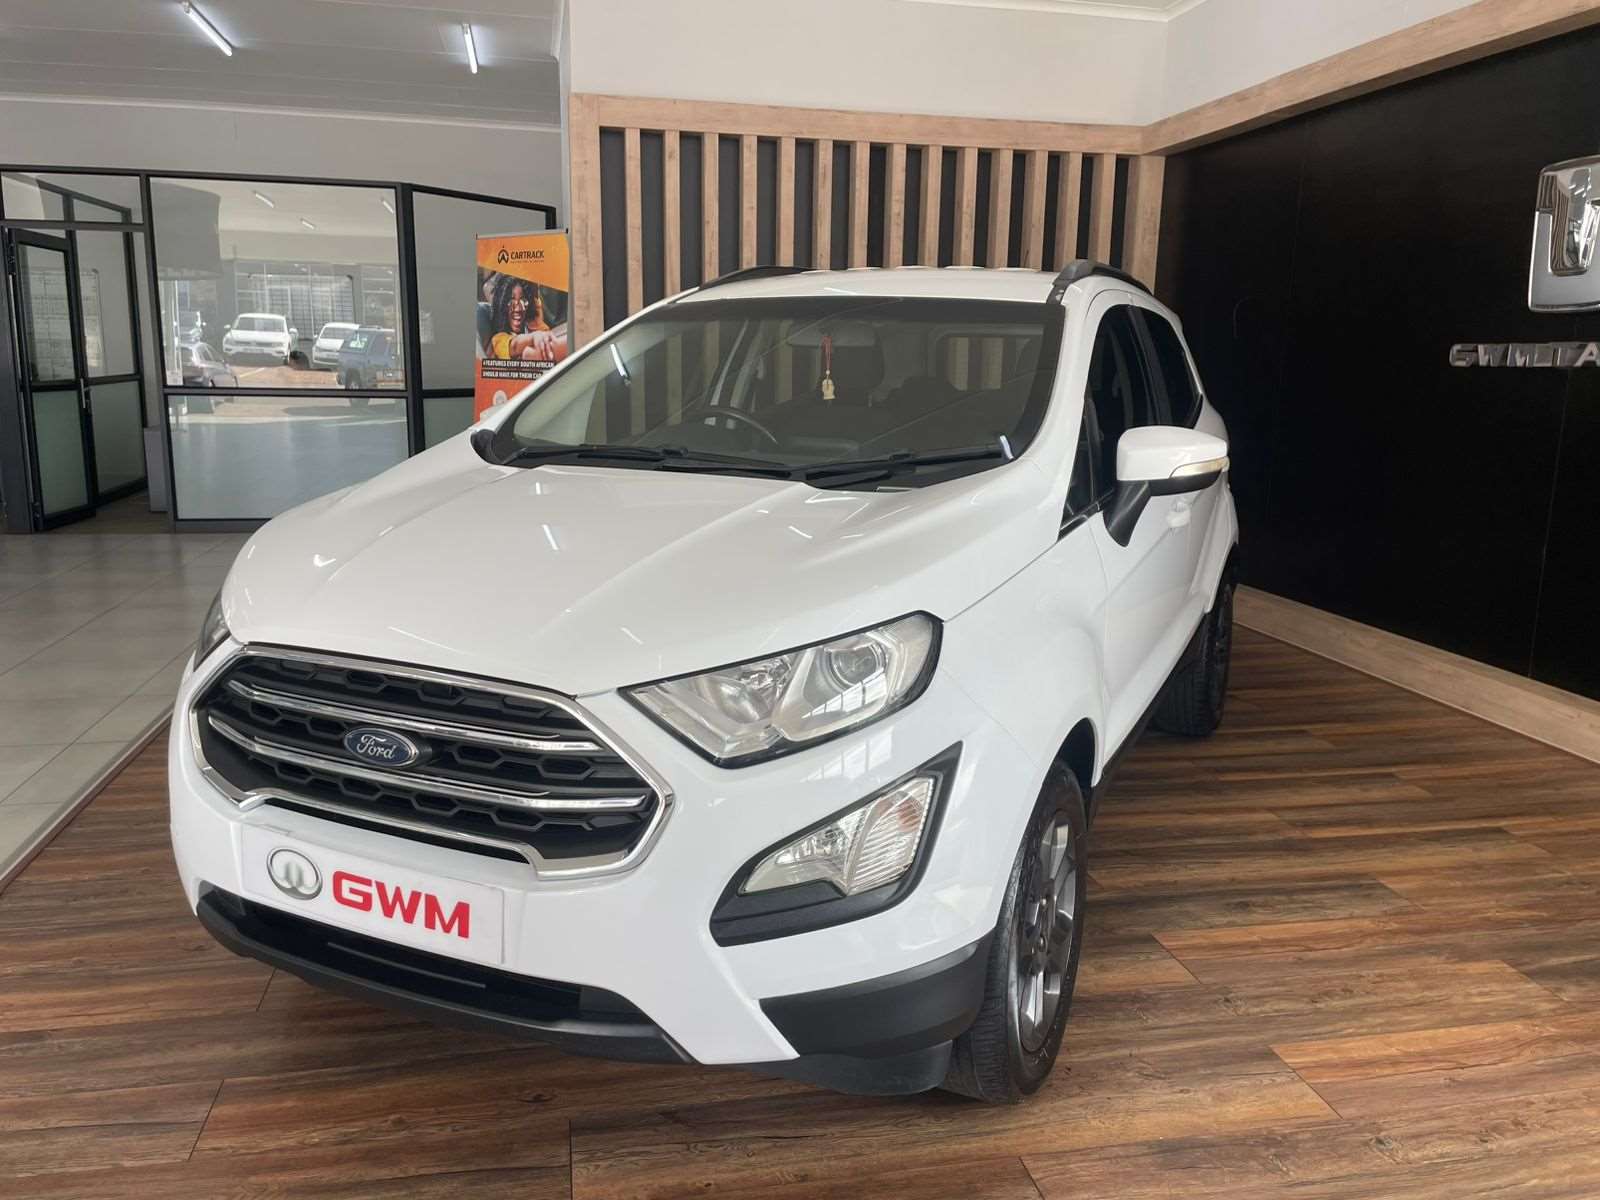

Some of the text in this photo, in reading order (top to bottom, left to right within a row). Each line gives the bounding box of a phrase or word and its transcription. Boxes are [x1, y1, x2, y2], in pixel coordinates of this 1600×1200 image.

[510, 250, 545, 260] CARTRACK
[356, 733, 397, 760] Ford
[332, 870, 471, 939] GWM
